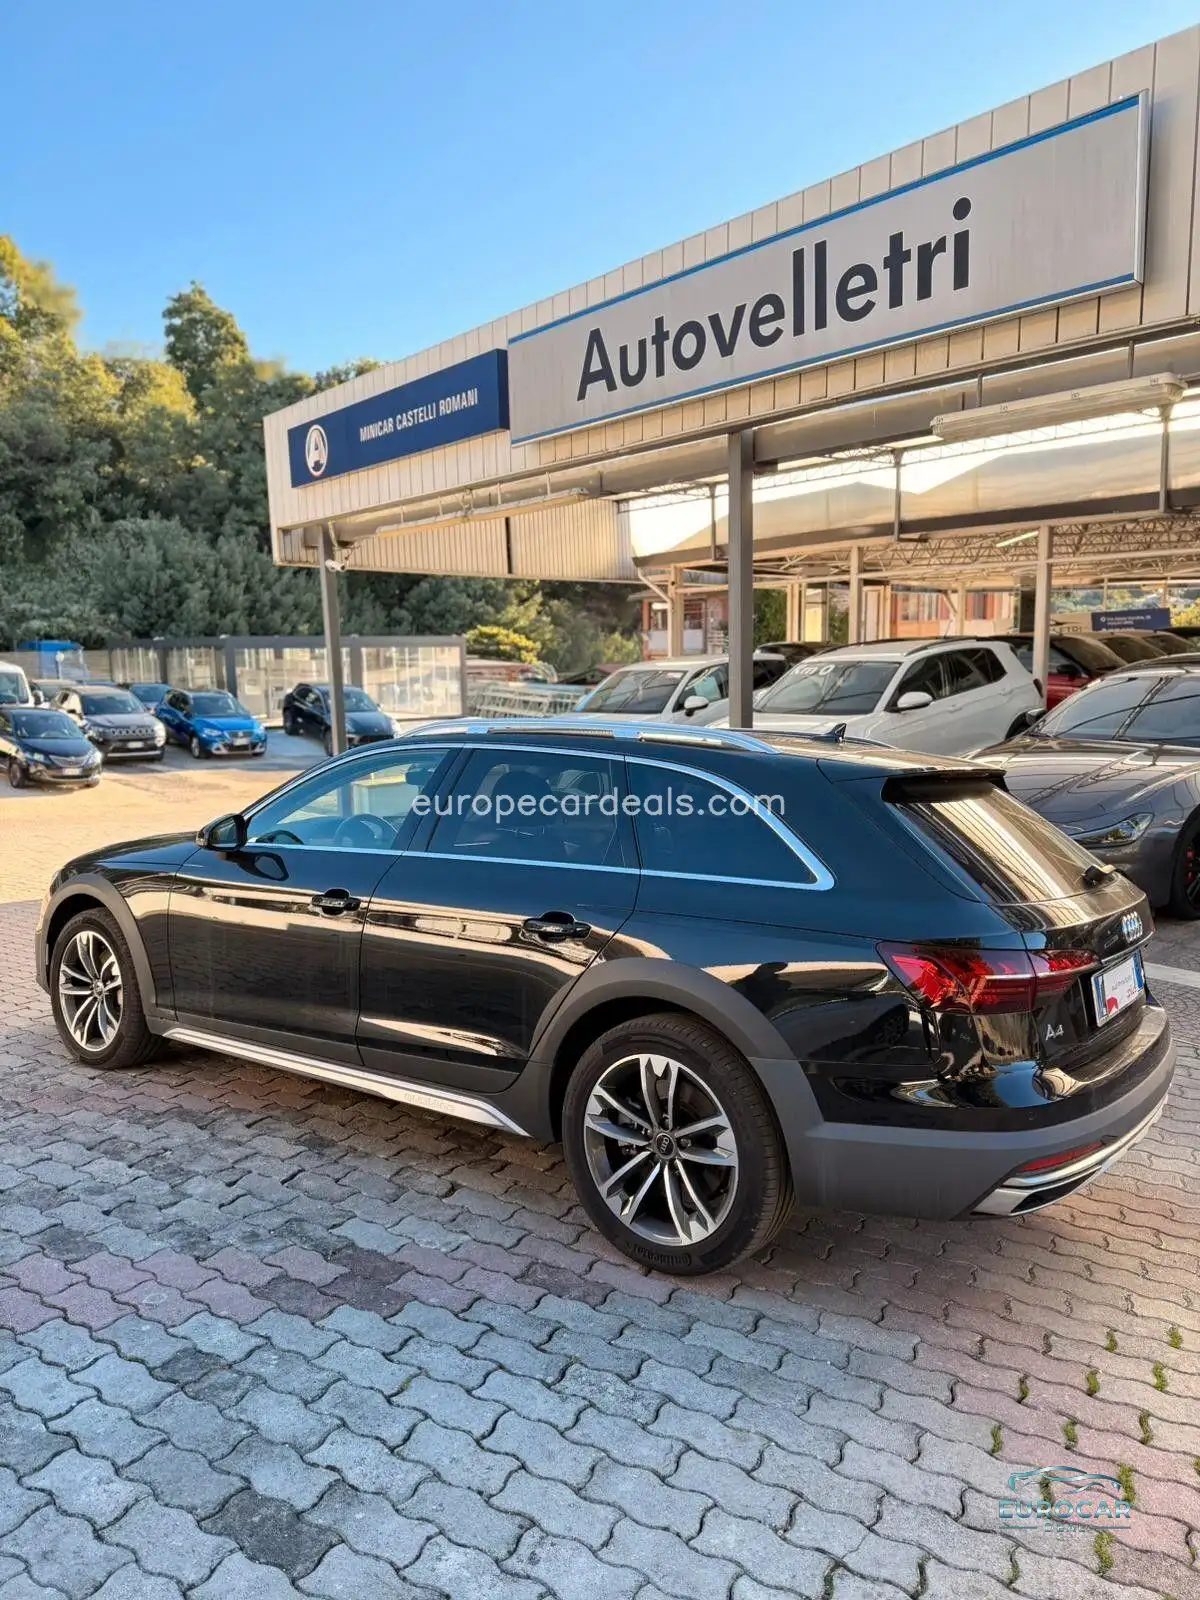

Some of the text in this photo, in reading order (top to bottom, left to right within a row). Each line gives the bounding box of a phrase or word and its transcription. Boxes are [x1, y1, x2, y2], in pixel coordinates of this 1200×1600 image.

[577, 197, 972, 401] Autovelletri
[359, 388, 478, 443] MINICAR CASTELLI ROMANI
[1045, 1024, 1064, 1040] A4
